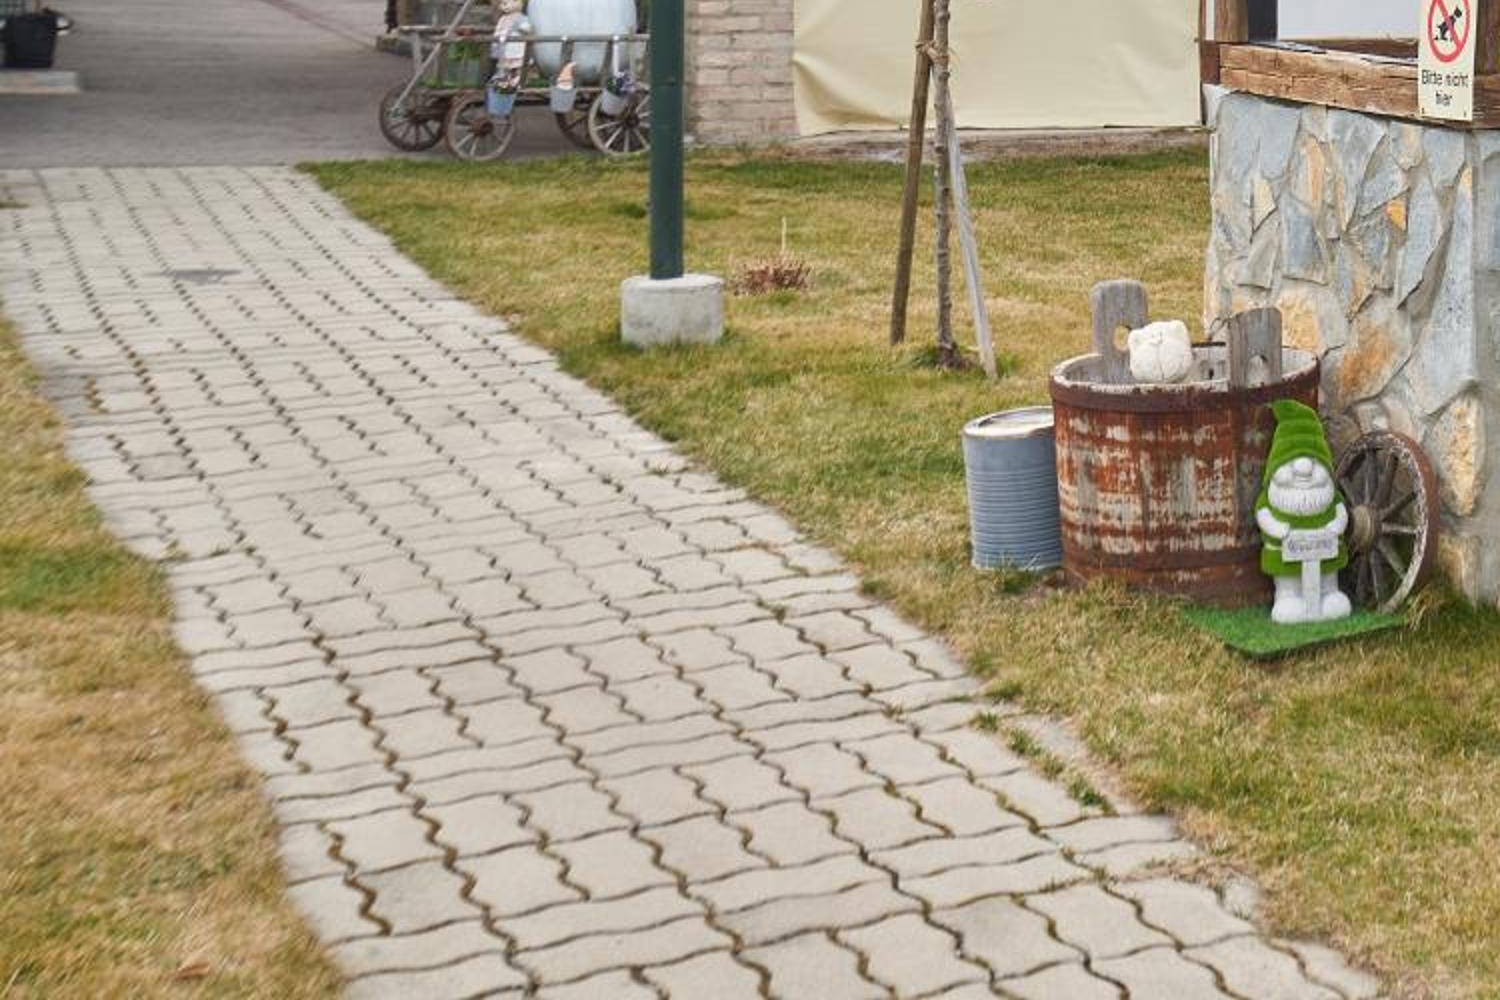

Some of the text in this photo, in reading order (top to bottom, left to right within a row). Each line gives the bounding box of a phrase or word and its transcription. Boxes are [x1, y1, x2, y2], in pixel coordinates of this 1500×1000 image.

[1421, 68, 1469, 89] Bitte nicht
[1435, 89, 1453, 107] hier
